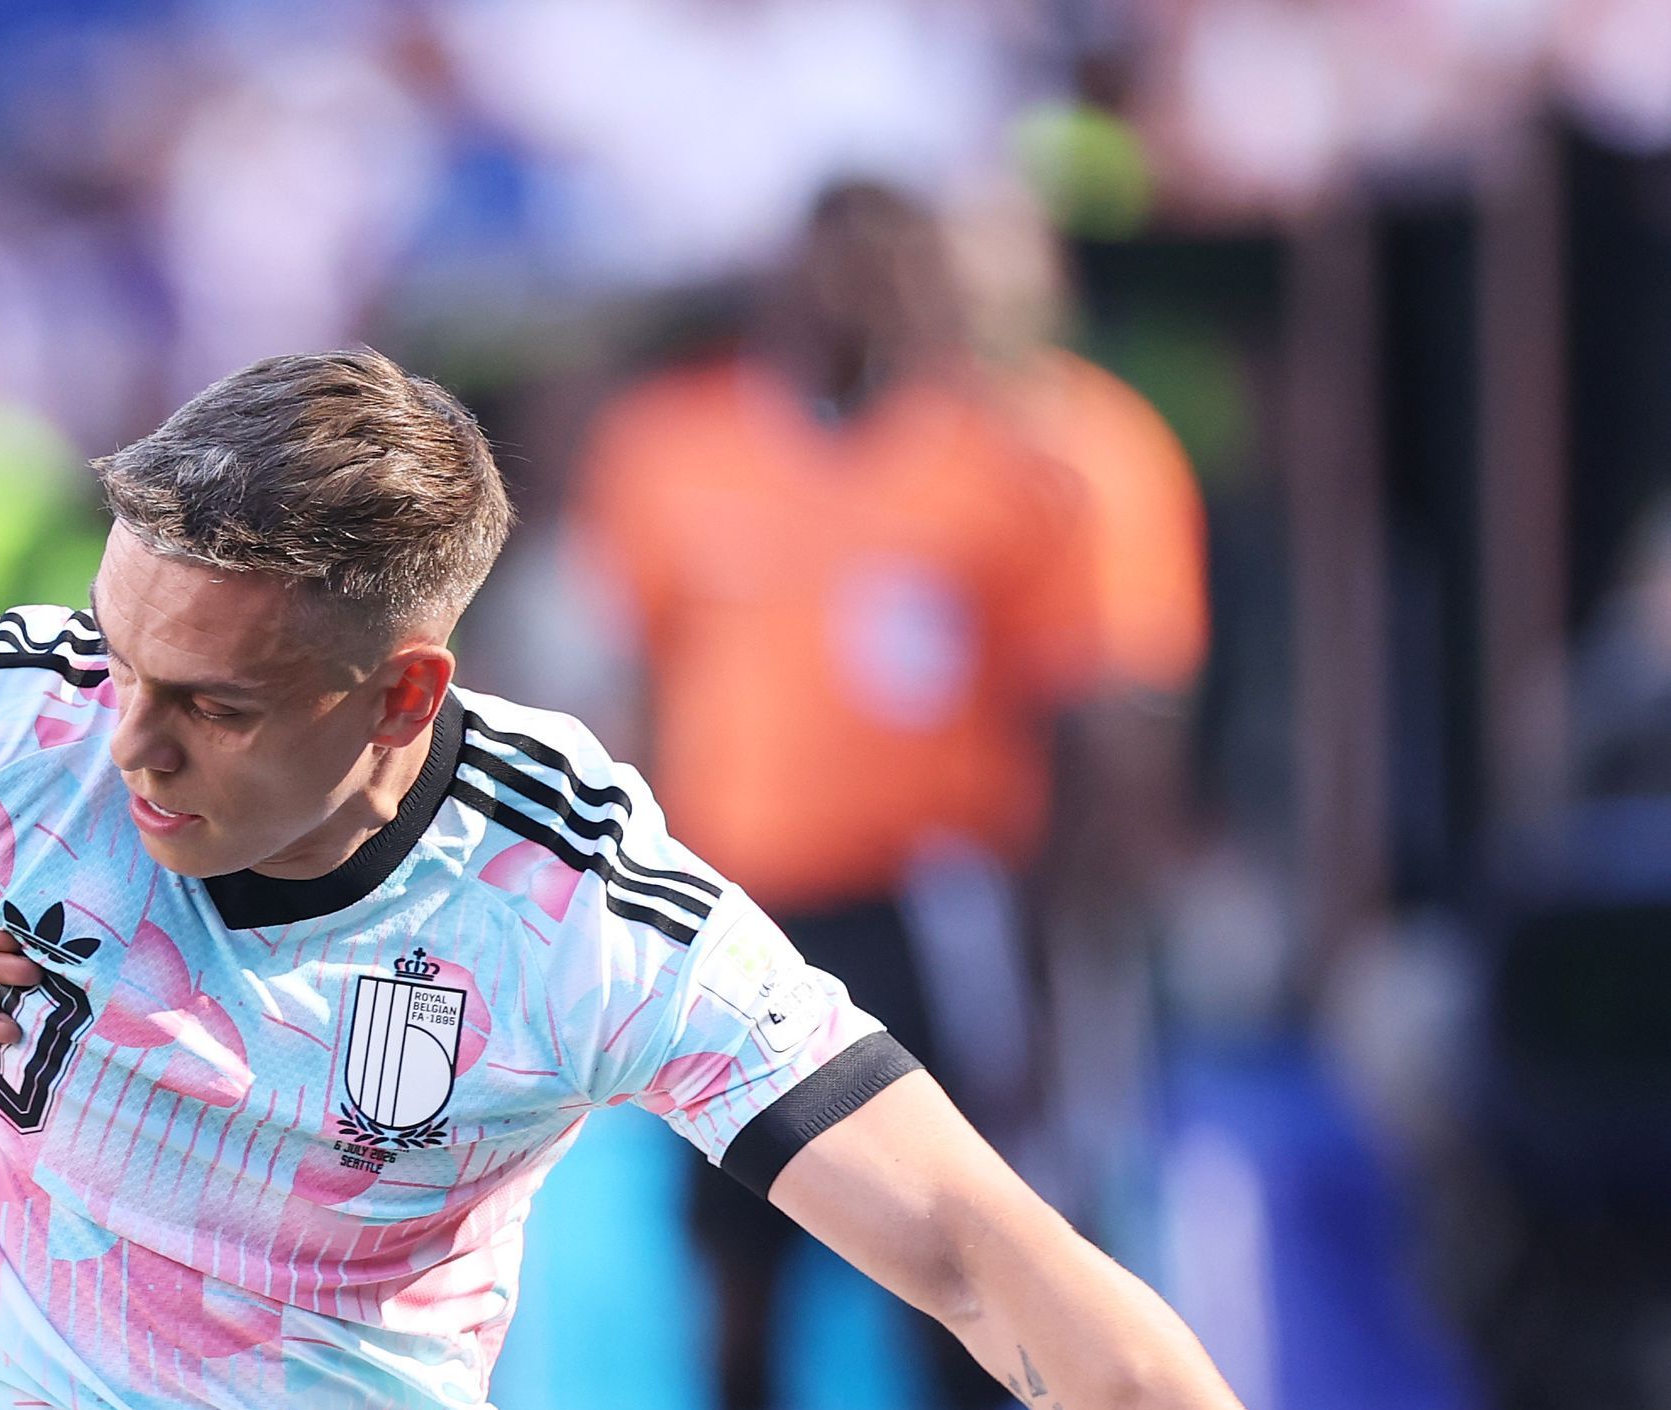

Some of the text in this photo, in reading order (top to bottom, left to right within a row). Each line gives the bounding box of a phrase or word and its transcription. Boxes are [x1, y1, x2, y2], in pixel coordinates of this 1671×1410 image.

[414, 991, 447, 1004] ROYAL
[413, 1002, 457, 1016] BELGIAN
[343, 1143, 369, 1157] JULY
[370, 1149, 398, 1164] 2026
[340, 1154, 384, 1175] SEATTLE
